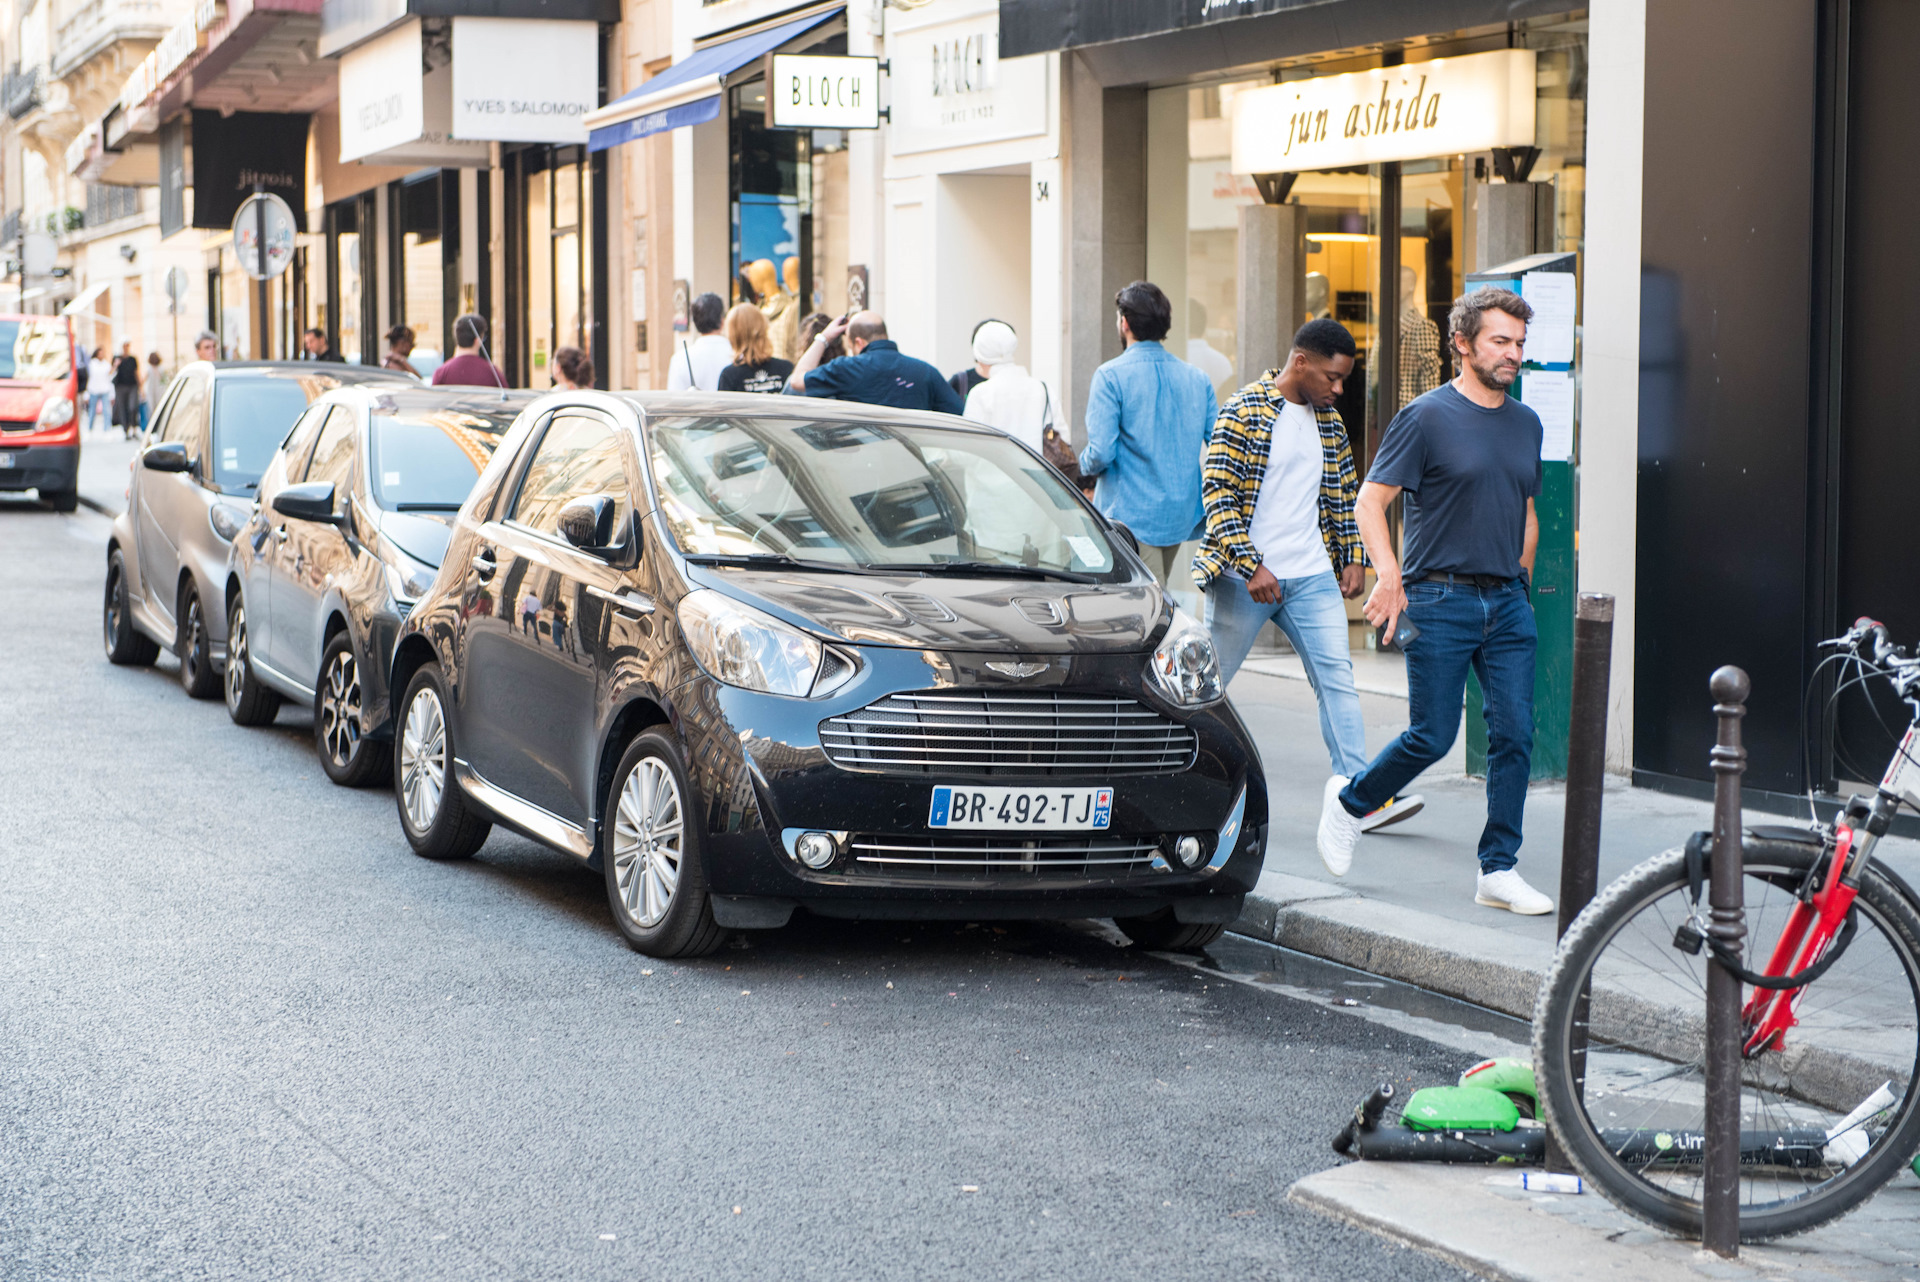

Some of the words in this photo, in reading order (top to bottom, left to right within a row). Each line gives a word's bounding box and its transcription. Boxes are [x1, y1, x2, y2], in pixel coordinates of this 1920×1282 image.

[792, 75, 860, 107] BLOCH
[464, 99, 506, 114] YVES
[510, 101, 590, 116] SALOMON
[1284, 93, 1330, 156] jun
[1343, 74, 1441, 138] ashida
[1036, 181, 1049, 202] 34
[936, 811, 943, 821] F
[951, 792, 1092, 824] BR-492-TJ
[1094, 810, 1109, 825] 75
[1674, 1132, 1705, 1150] Lim
